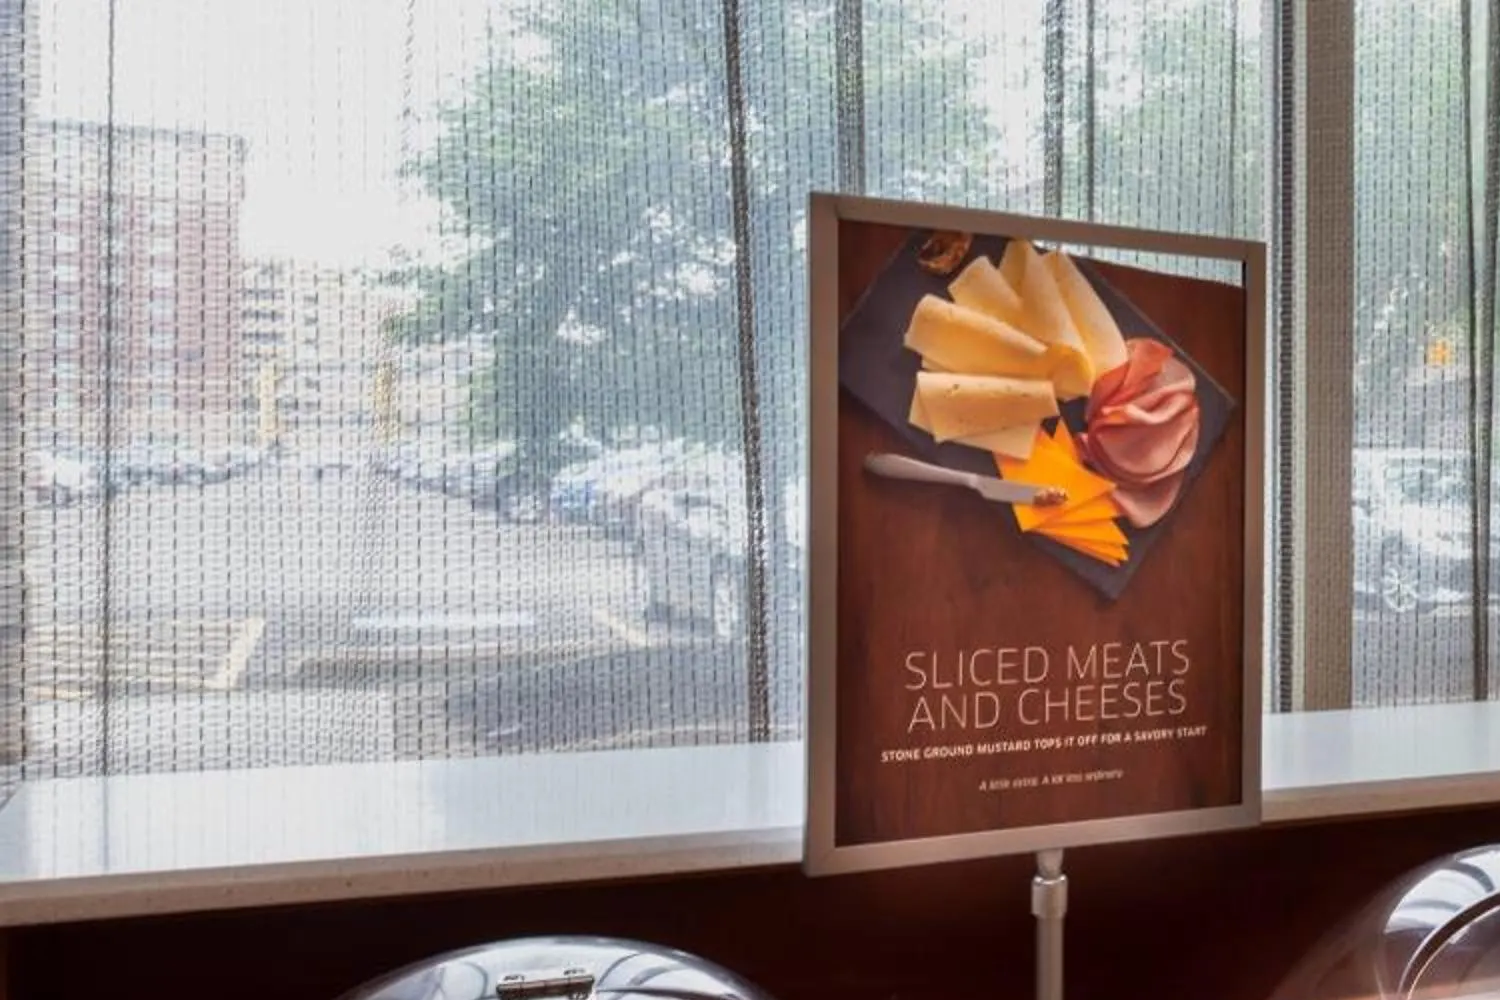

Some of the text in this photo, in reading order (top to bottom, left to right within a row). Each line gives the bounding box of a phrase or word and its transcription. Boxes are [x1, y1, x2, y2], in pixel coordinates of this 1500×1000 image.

[904, 639, 1191, 691] SLICED MEATS
[907, 678, 1187, 733] AND CHEESES
[881, 725, 1208, 763] STONE GROUND MUSTARD TOPS IT OFF FOR A SAVORY START
